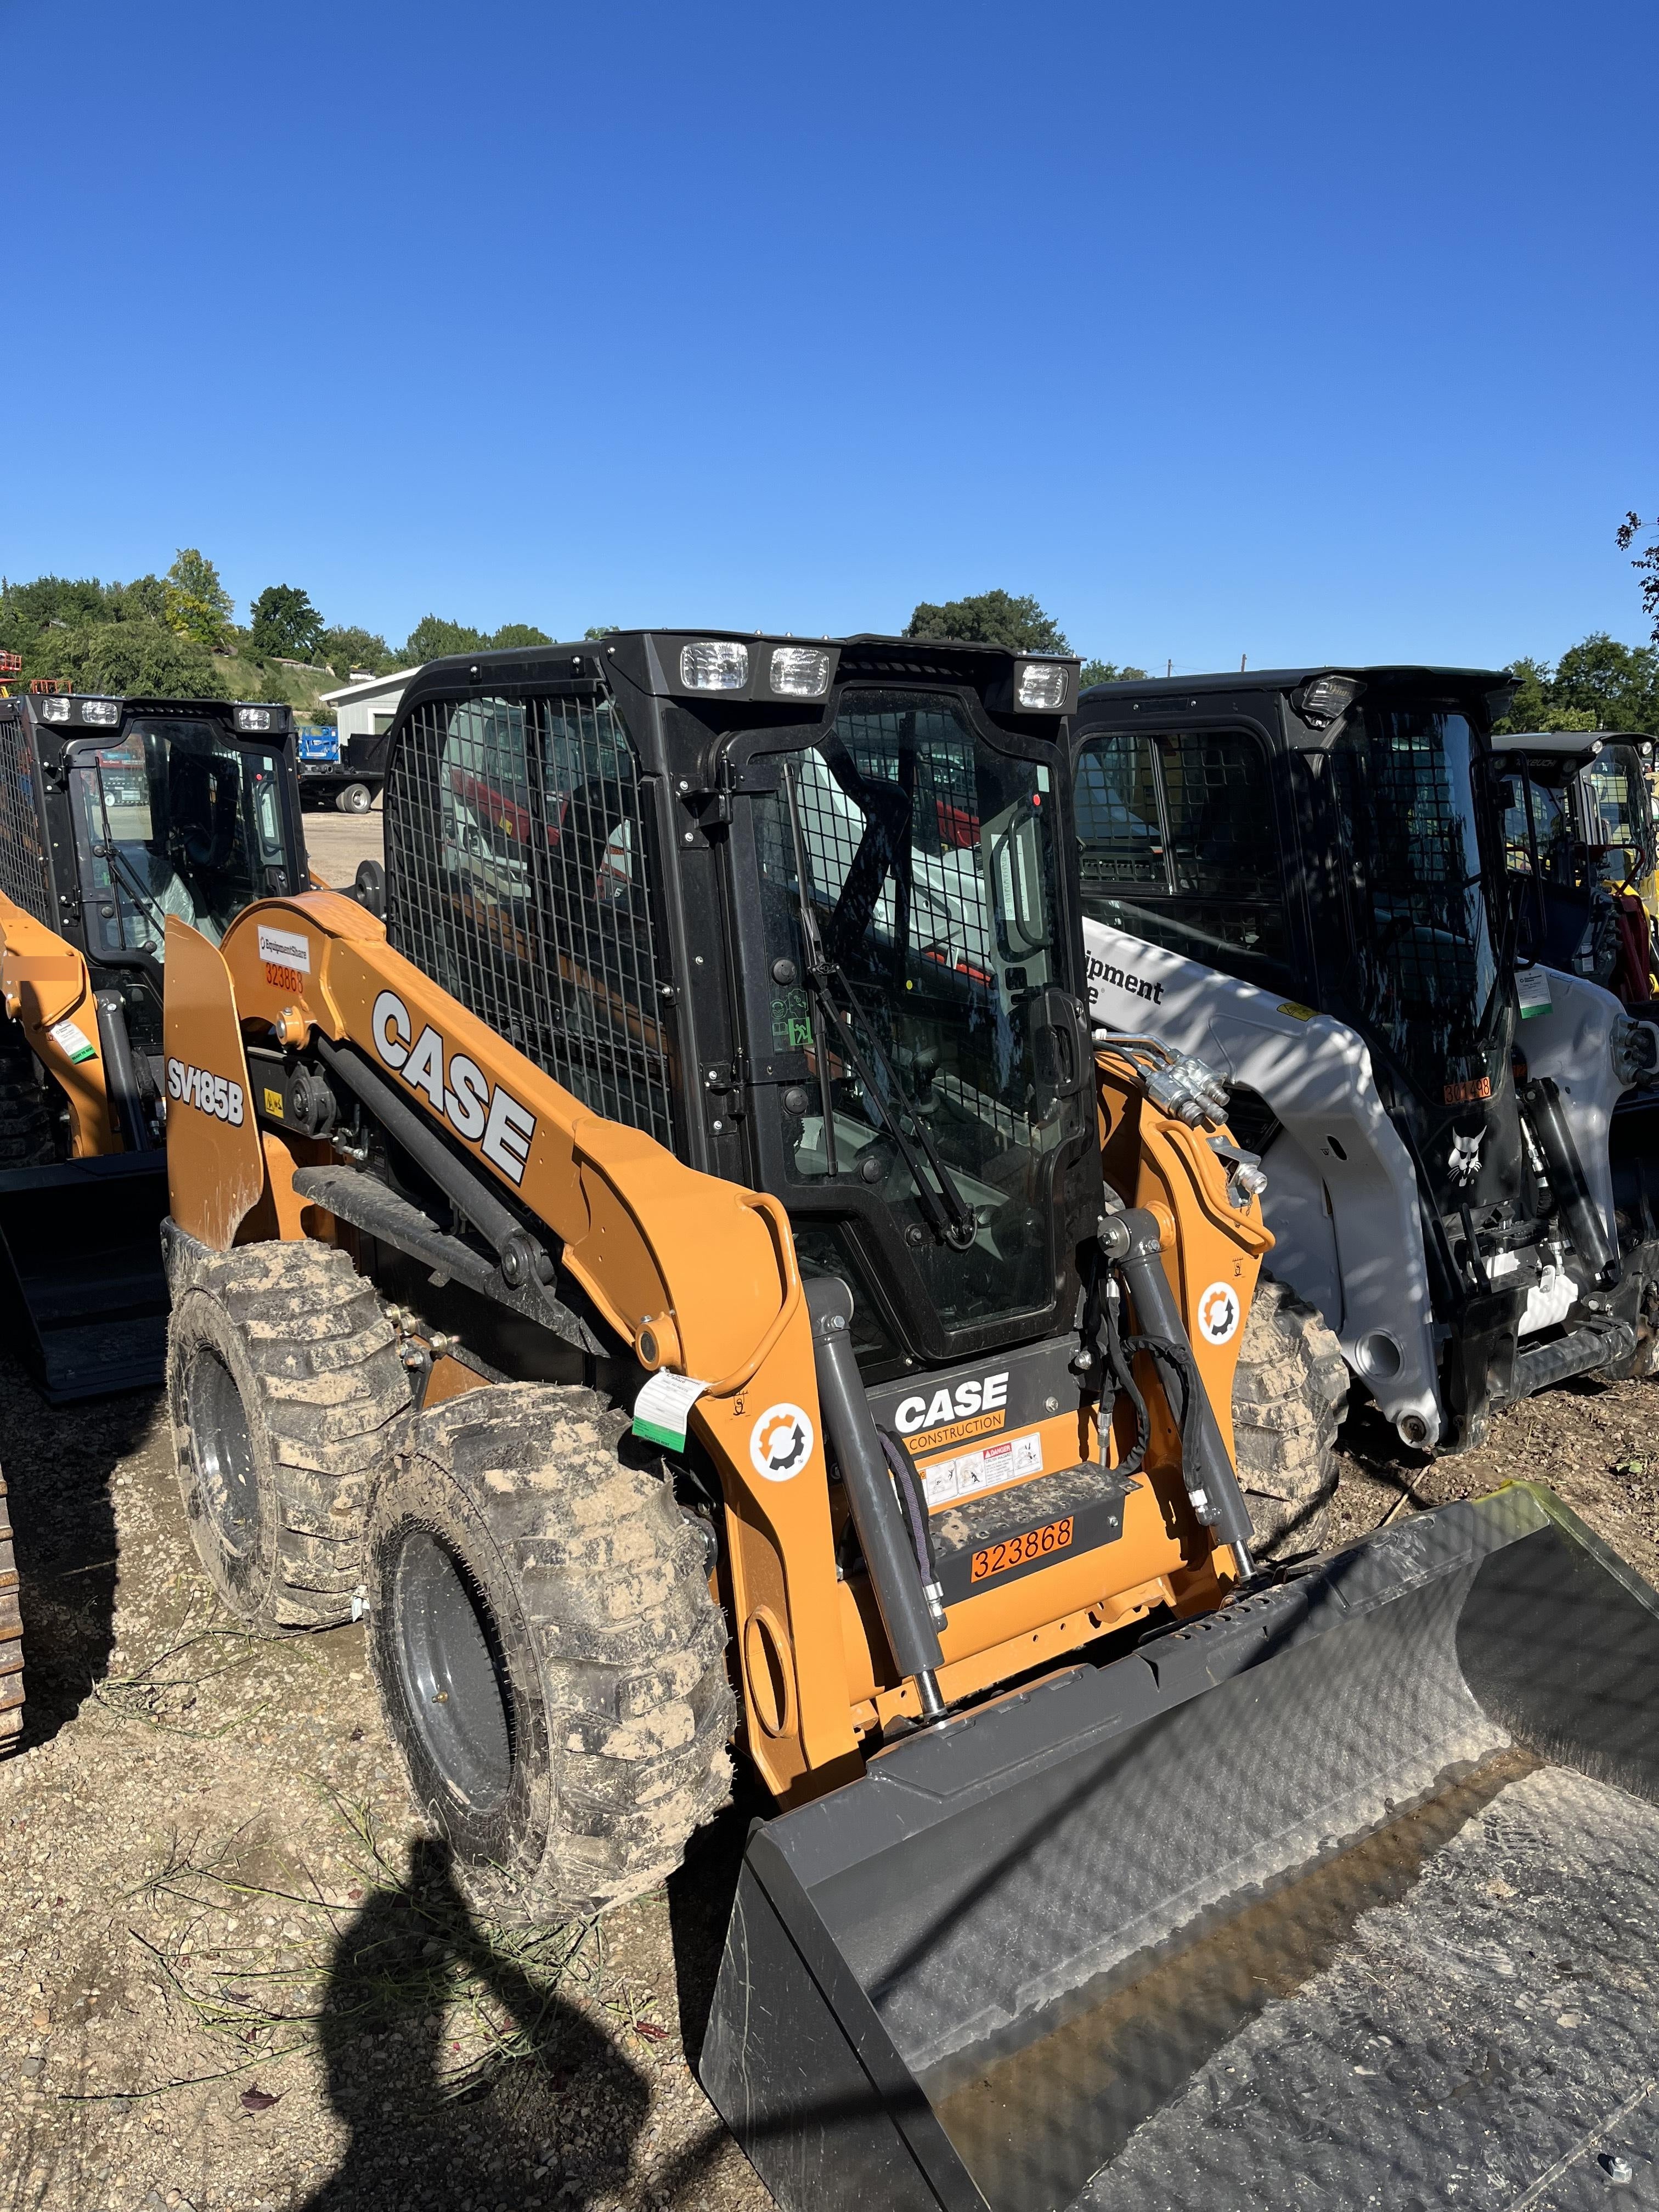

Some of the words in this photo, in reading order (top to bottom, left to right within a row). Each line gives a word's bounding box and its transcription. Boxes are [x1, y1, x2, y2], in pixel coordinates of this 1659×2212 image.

[266, 962, 303, 994] 323868
[167, 1057, 244, 1127] SV185B
[372, 989, 537, 1188] CASE
[1445, 1078, 1489, 1103] 301498
[895, 1372, 1009, 1433] CASE
[910, 1414, 1001, 1450] CONSTRUCTION
[991, 1445, 1011, 1456] DANGER
[974, 1519, 1070, 1577] 323868
